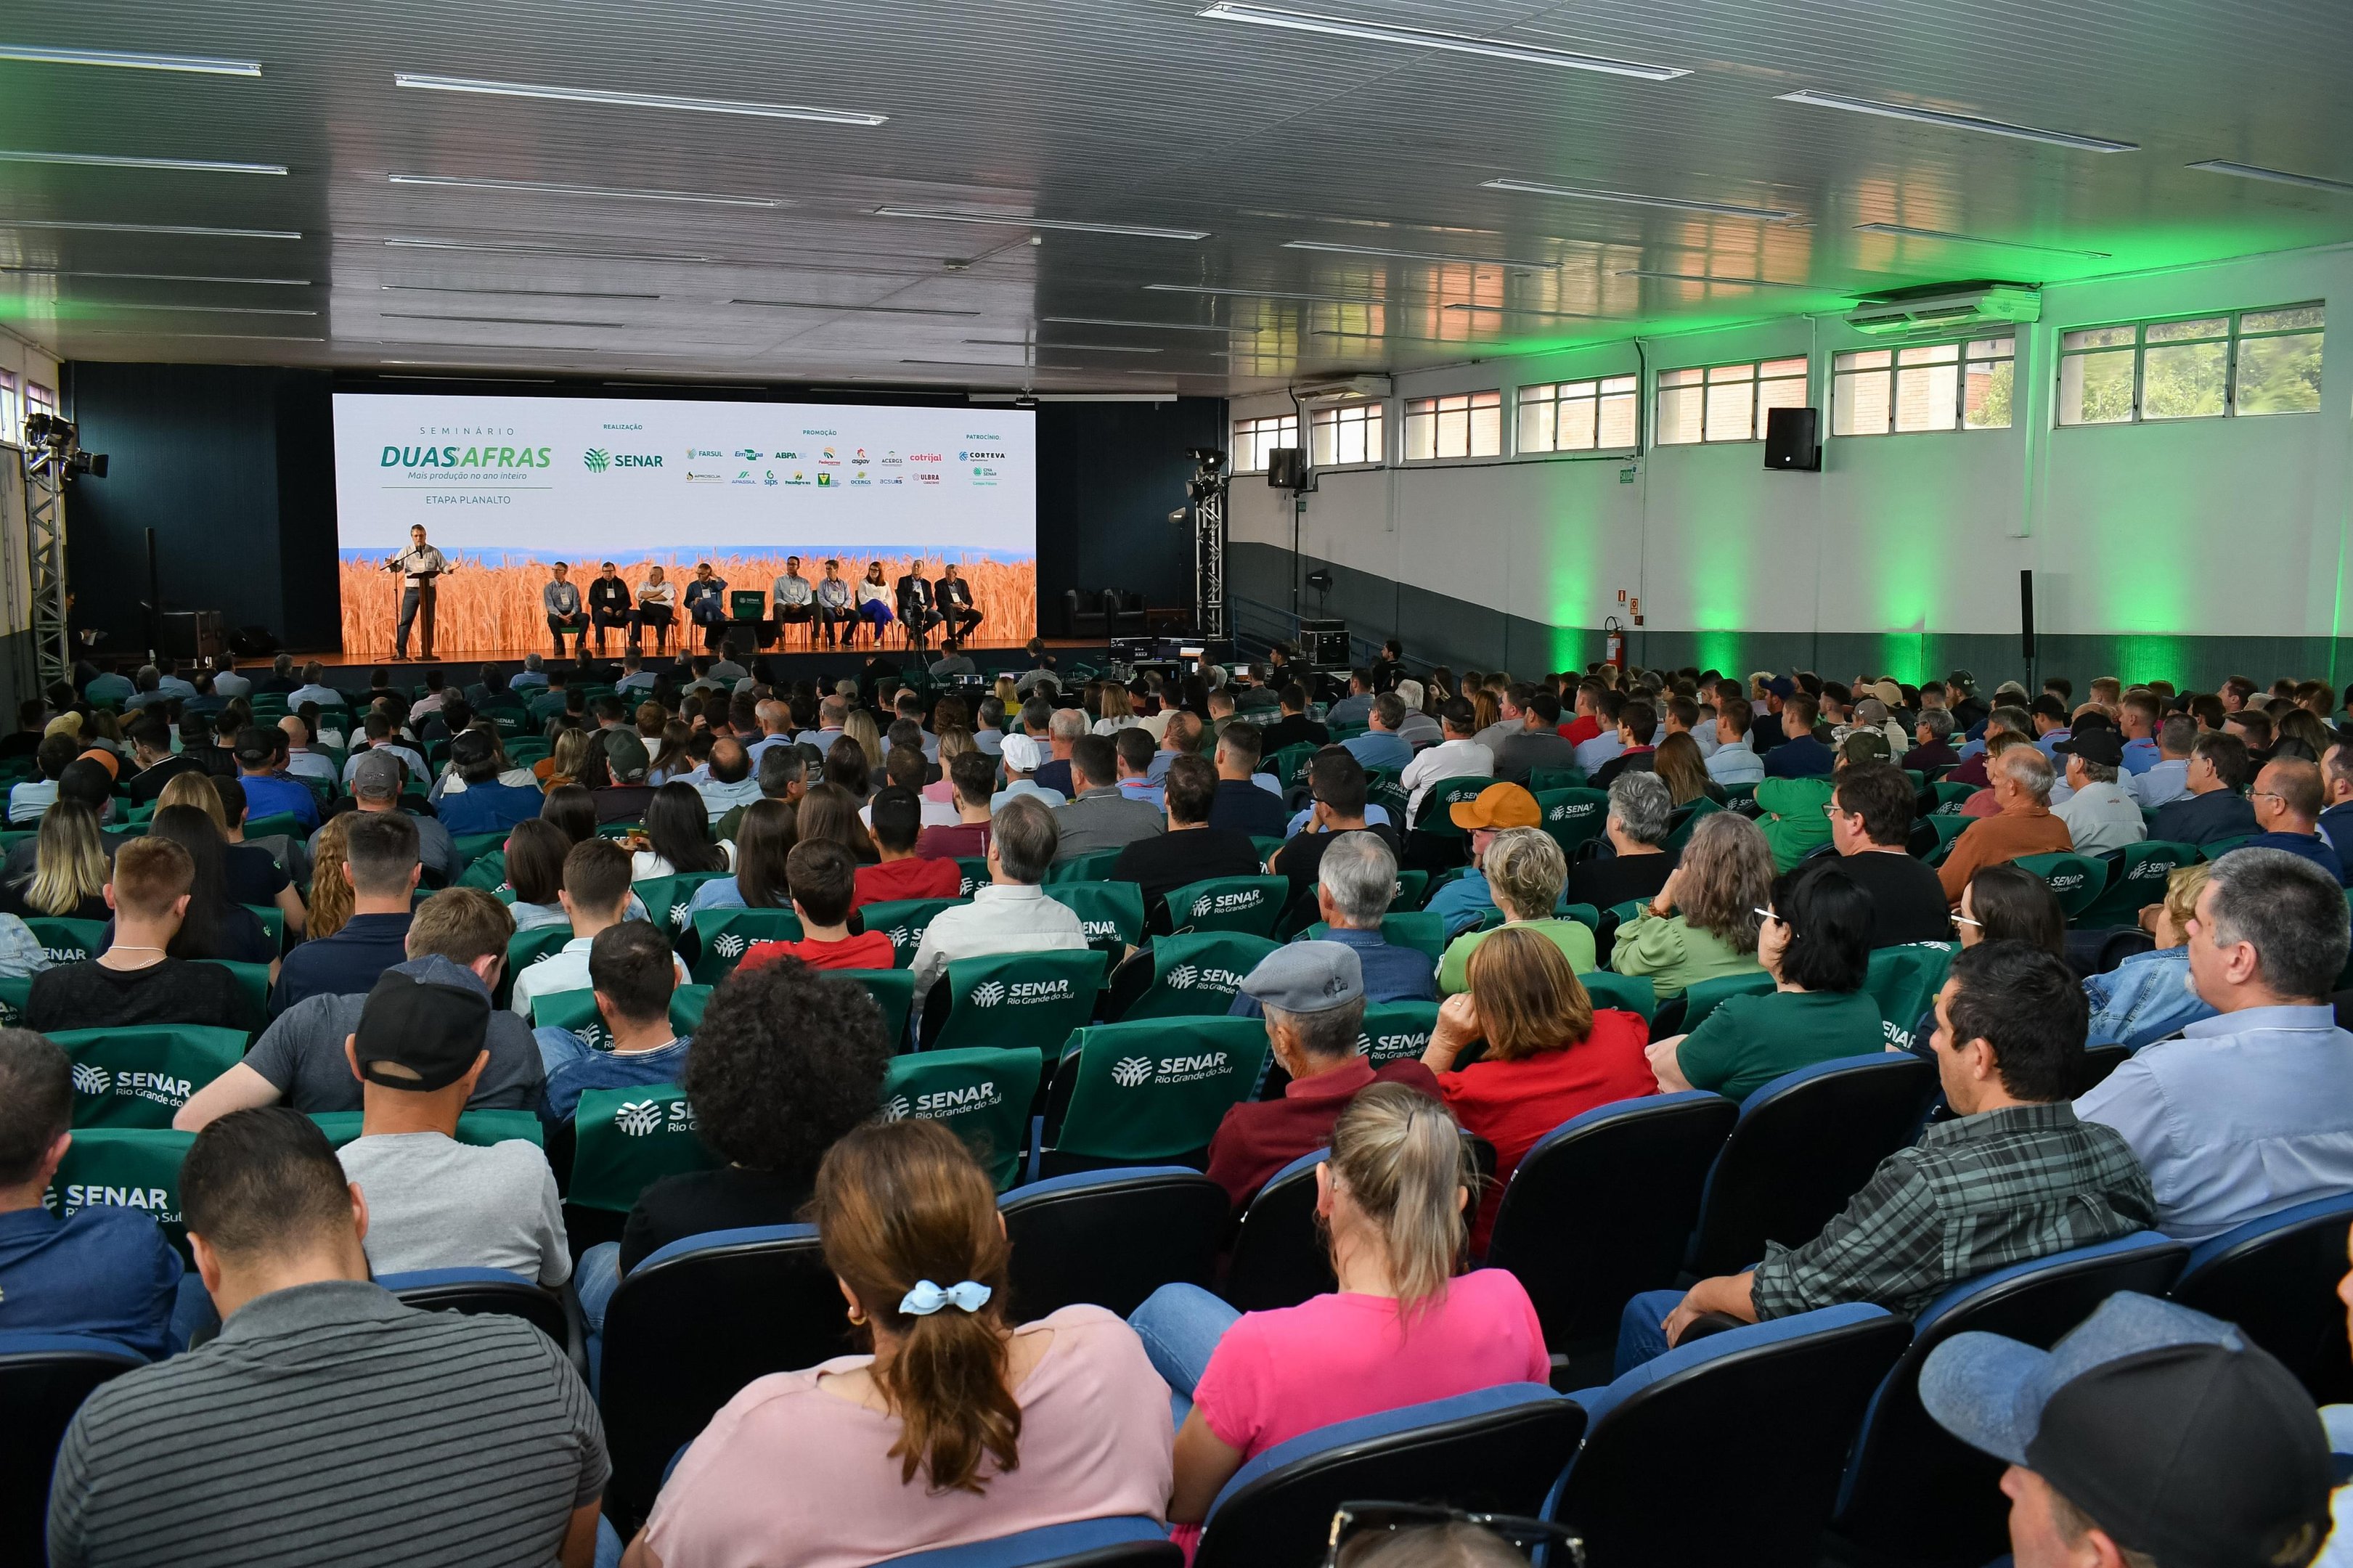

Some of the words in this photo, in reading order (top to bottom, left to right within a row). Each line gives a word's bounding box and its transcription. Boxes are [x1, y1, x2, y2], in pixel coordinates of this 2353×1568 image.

[420, 425, 514, 436] SEMINÁRIO
[614, 454, 664, 467] SENAR
[910, 453, 942, 463] cotrijal
[408, 471, 428, 480] Mais
[429, 471, 468, 481] produção
[500, 471, 527, 480] inteiro
[426, 496, 457, 505] ETAPA
[460, 496, 511, 505] PLANALTO
[1566, 802, 1594, 814] SENAR
[1215, 889, 1260, 907] SENAR
[1225, 904, 1247, 912] Grande
[1082, 920, 1117, 934] ENAR
[41, 947, 86, 960] ENAR
[1200, 969, 1244, 987] SENA
[1008, 979, 1069, 997] SENAR
[1209, 983, 1235, 995] Grande
[1021, 995, 1050, 1005] Grande
[1387, 1049, 1416, 1059] Grande
[1157, 1052, 1228, 1074] SENAR
[1154, 1075, 1171, 1084] Rio
[1172, 1071, 1205, 1083] Grande
[1205, 1068, 1218, 1077] do
[1218, 1066, 1233, 1074] Sul
[116, 1071, 192, 1098] SENAR
[135, 1088, 168, 1105] Grande
[169, 1097, 184, 1108] do
[915, 1082, 994, 1111] SENAR
[915, 1111, 933, 1120] Rio
[934, 1104, 972, 1119] Grande
[974, 1100, 987, 1111] do
[988, 1093, 1002, 1106] Sul
[668, 1122, 687, 1132] Rio
[66, 1185, 168, 1209] SENAR
[161, 1212, 182, 1222] Sul
